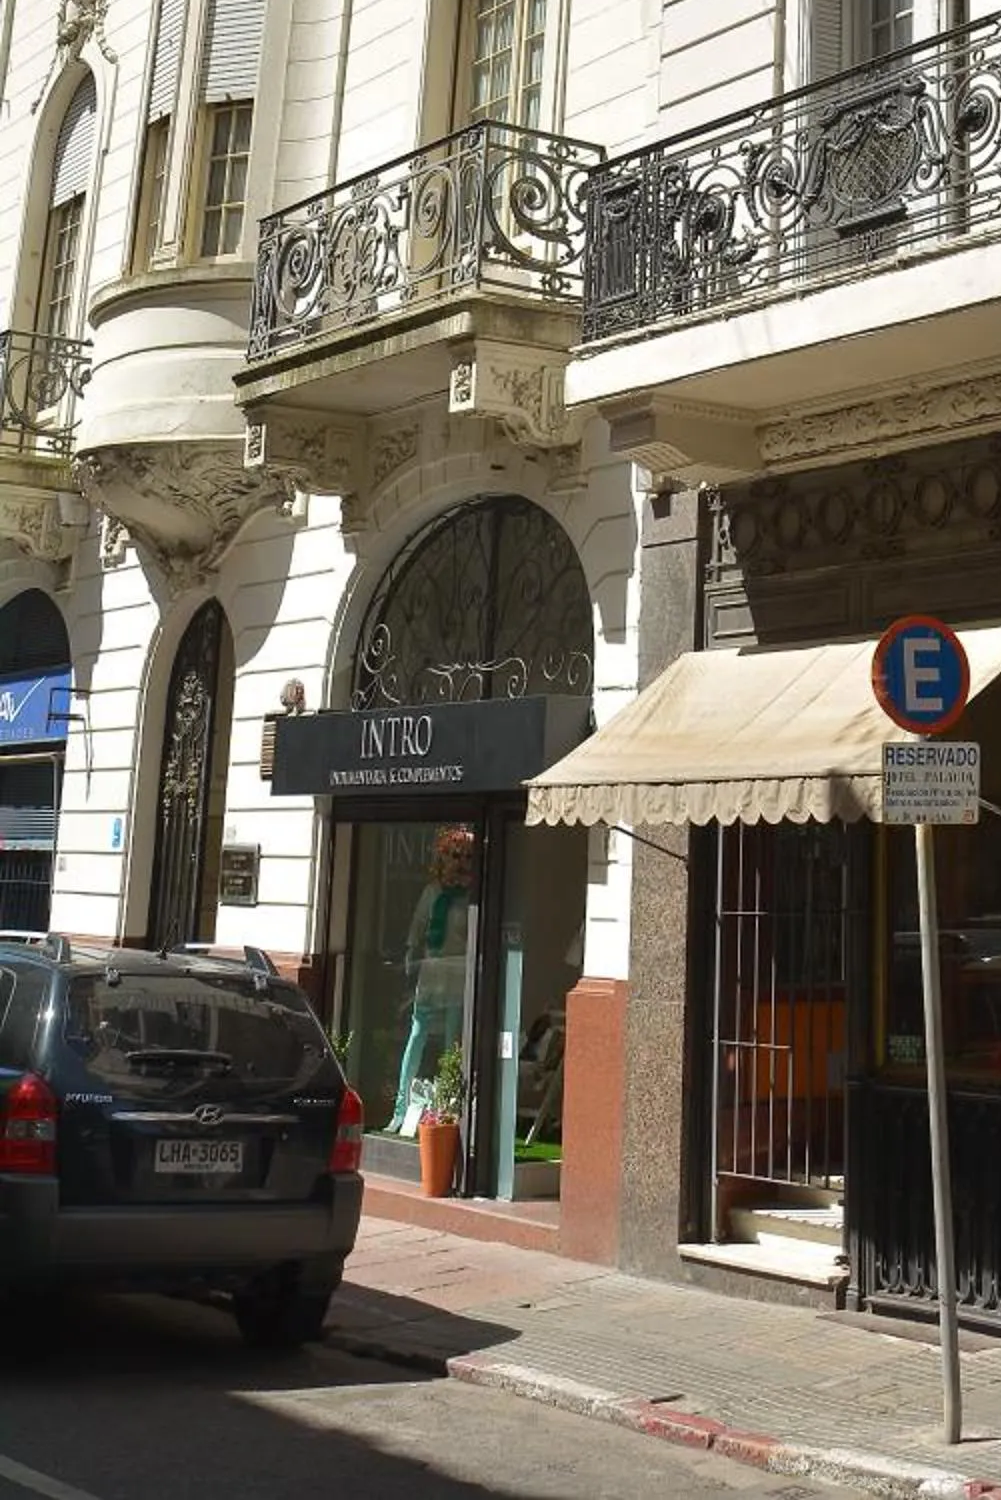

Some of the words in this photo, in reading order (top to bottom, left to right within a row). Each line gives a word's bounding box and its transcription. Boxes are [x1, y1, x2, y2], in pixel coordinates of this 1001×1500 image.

[902, 637, 944, 712] E
[359, 715, 433, 759] INTRO
[885, 746, 977, 767] RESERVADO
[159, 1142, 191, 1163] LHA
[198, 1142, 239, 1163] 3065
